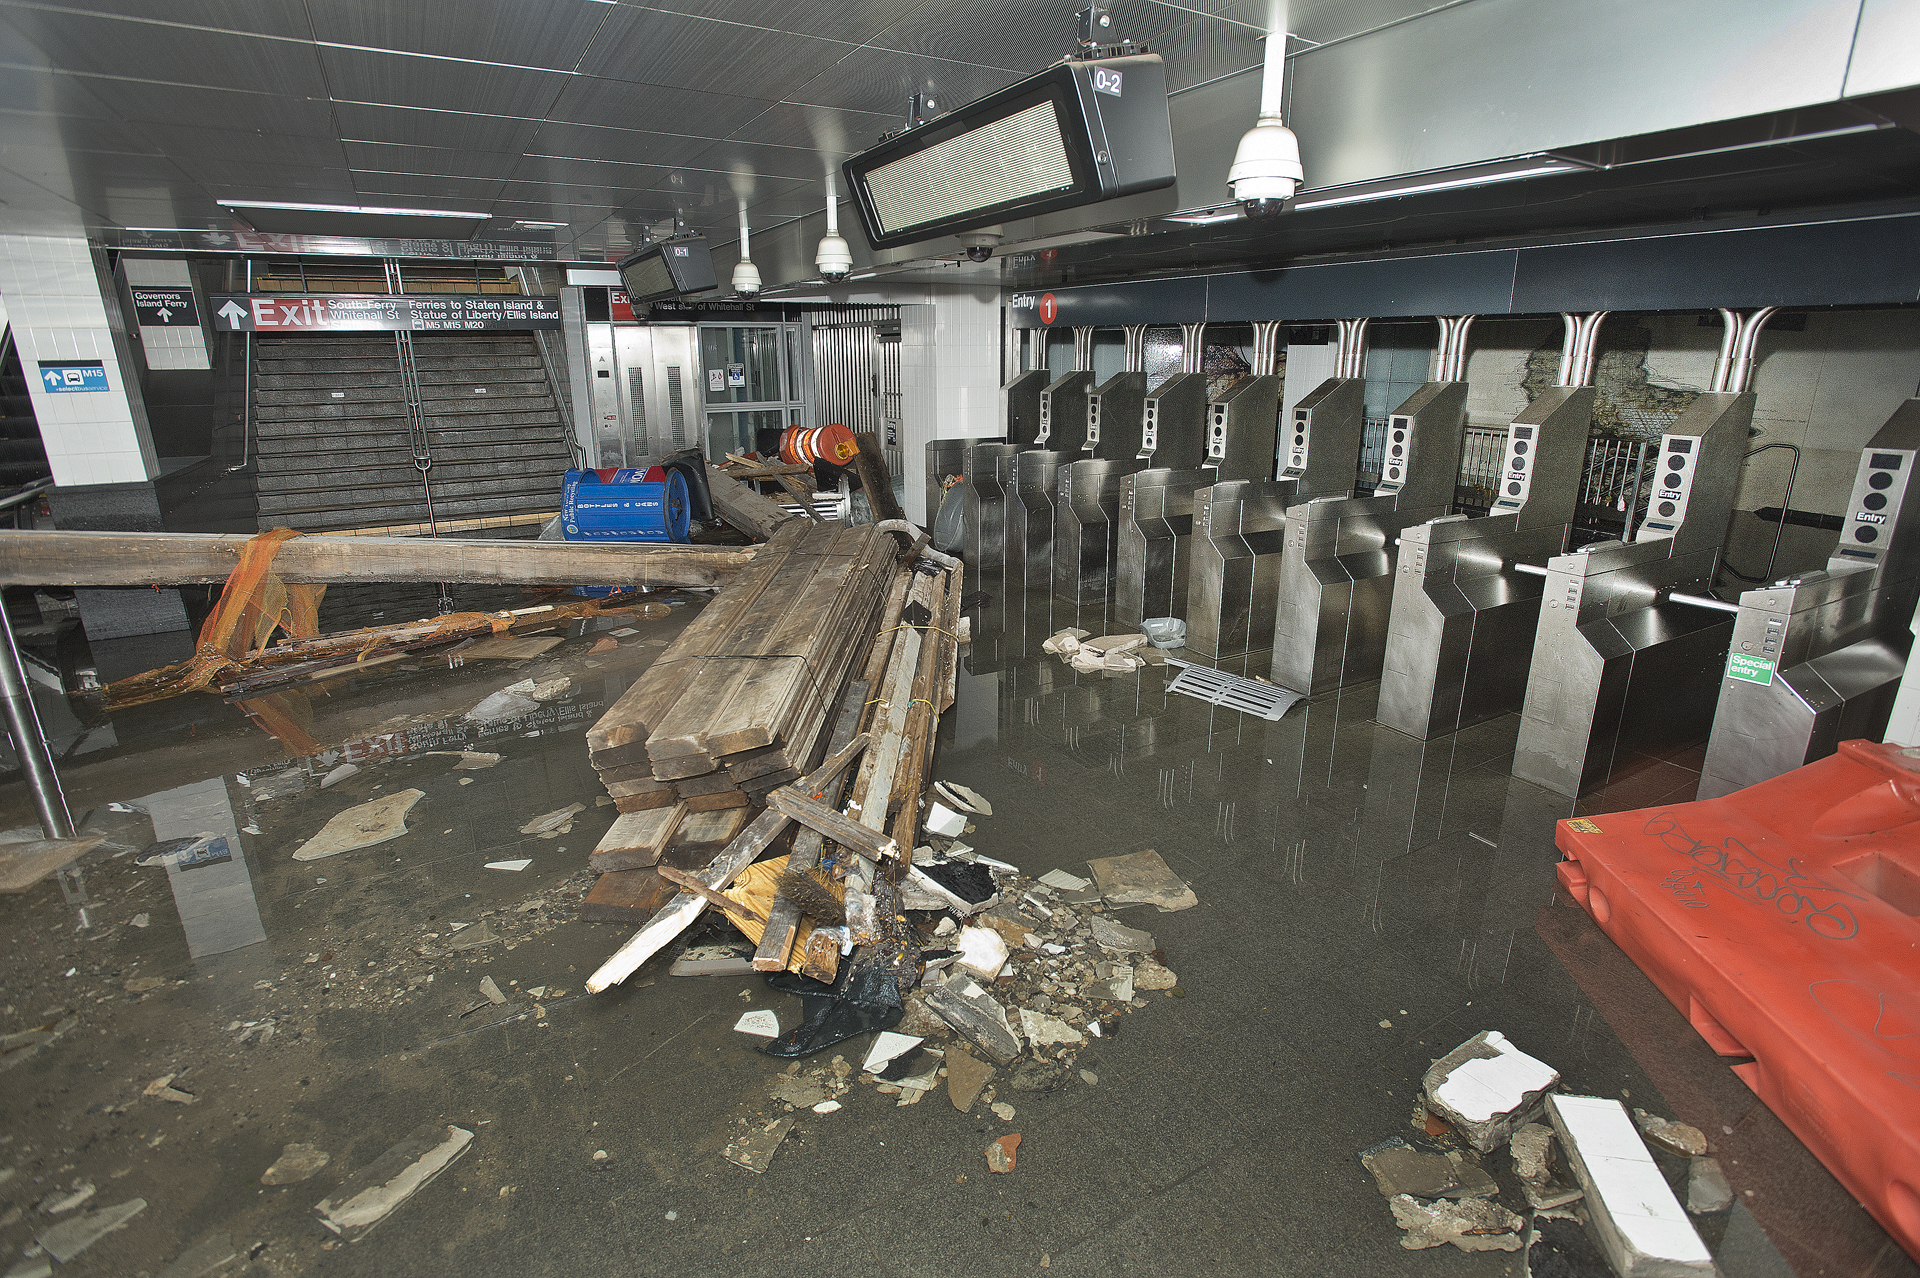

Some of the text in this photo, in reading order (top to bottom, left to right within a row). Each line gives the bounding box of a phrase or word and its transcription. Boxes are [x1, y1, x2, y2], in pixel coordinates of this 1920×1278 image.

[1096, 70, 1121, 94] 0-2
[675, 248, 687, 256] 0-1
[134, 292, 181, 300] Governors
[611, 292, 631, 304] Exi
[1012, 293, 1036, 310] Entry
[136, 300, 188, 309] Island Ferry
[328, 300, 397, 312] South Ferry
[408, 300, 544, 310] Ferries to Staten Island &
[655, 302, 677, 311] West
[698, 302, 706, 311] of
[709, 302, 744, 311] Whitehall
[746, 302, 755, 311] St
[250, 298, 328, 327] Exit
[329, 310, 400, 320] Whitehall St
[410, 310, 559, 321] Statue of Liberty/Ellis Island
[426, 321, 485, 330] M5 M15 M20
[82, 369, 104, 378] M15
[1507, 471, 1526, 482] Entry
[1658, 489, 1681, 501] Entry
[1856, 511, 1886, 525] Entry
[1733, 655, 1773, 671] Special
[1731, 665, 1759, 678] entry
